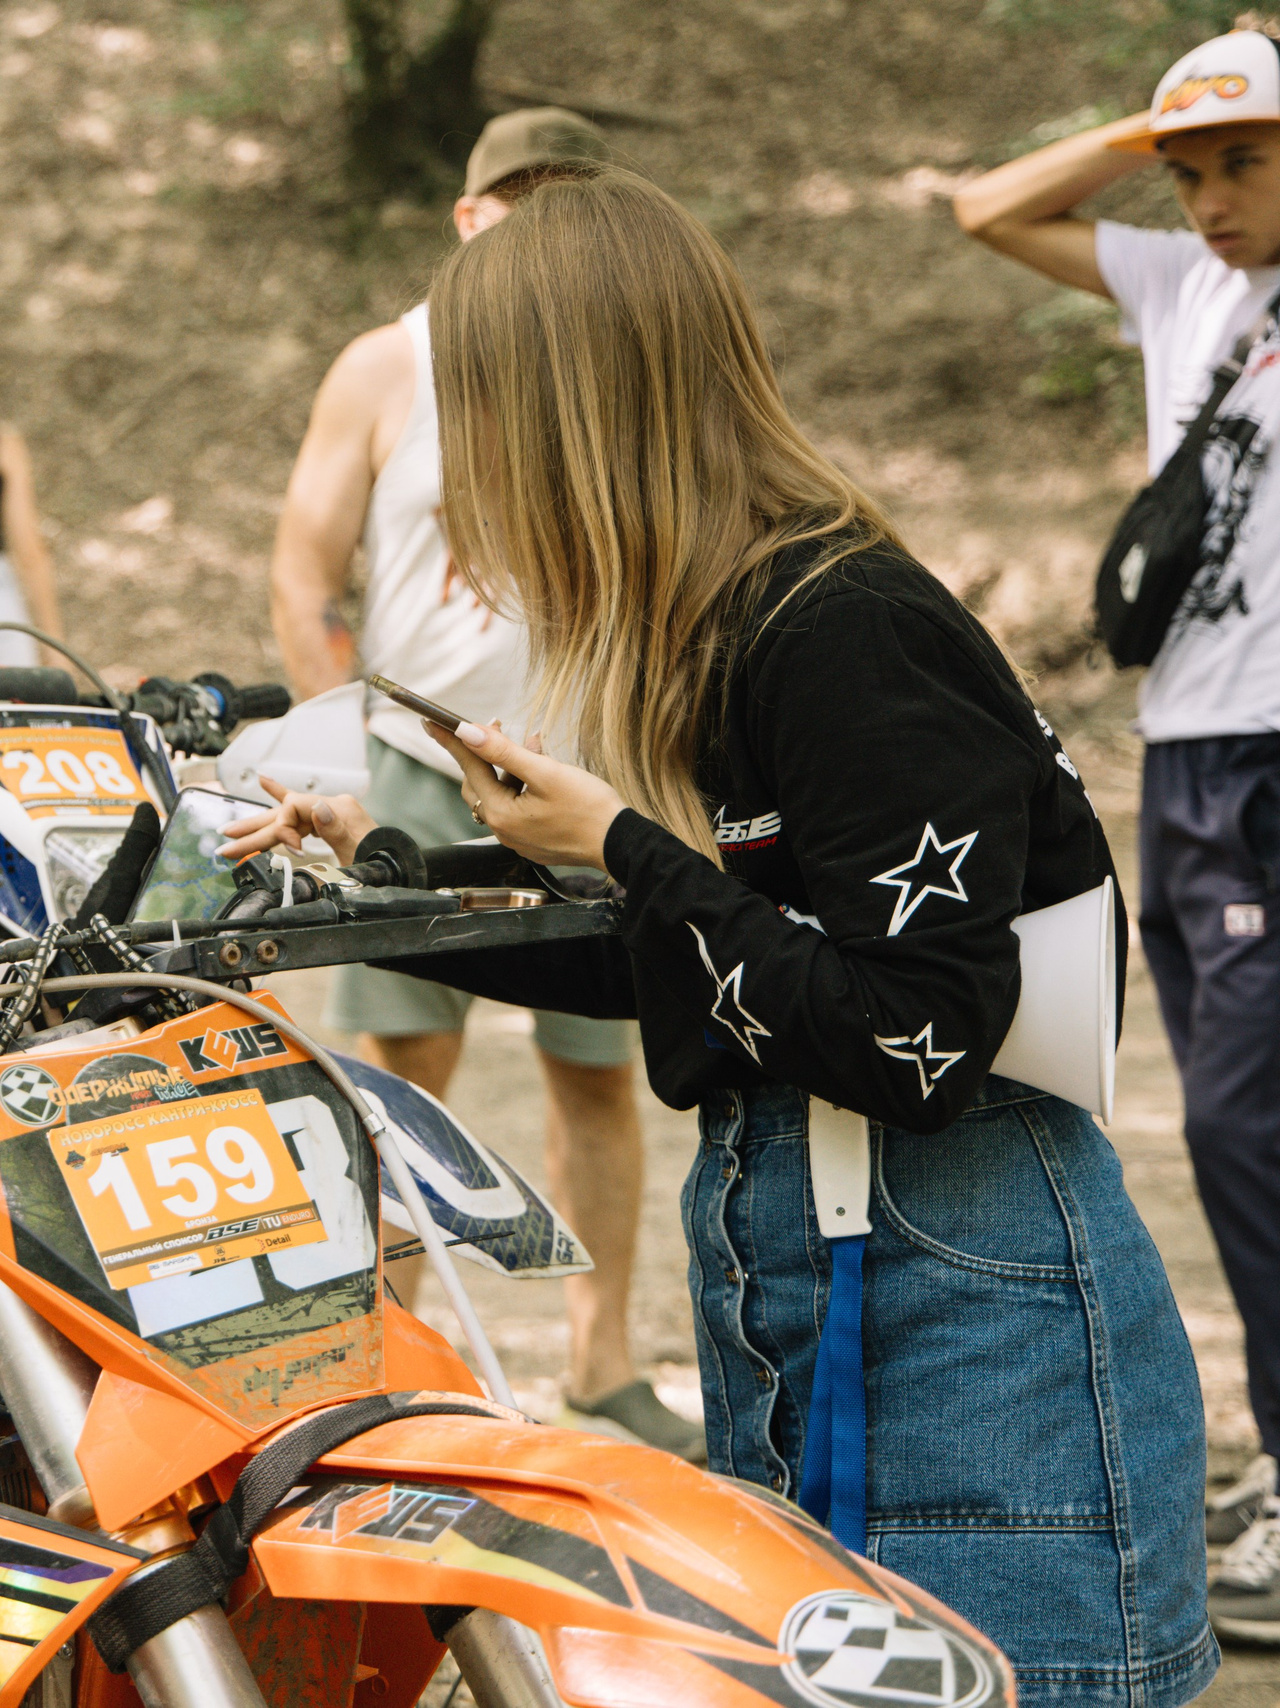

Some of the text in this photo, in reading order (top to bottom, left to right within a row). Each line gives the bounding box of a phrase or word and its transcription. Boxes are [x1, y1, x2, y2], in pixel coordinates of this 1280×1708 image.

[1, 749, 136, 796] 208
[743, 835, 778, 852] TEAM
[154, 1079, 197, 1101] RACE
[60, 1093, 259, 1147] НОВОРОСС КАНТРИ-КРОСС
[87, 1125, 275, 1232] 159
[184, 1215, 218, 1229] БРОНЗА
[204, 1217, 260, 1243] BSE
[263, 1210, 312, 1229] TU ENDURO
[102, 1232, 204, 1265] ГЕНЕРАЛЬНЫЙ СПОНСОР
[265, 1233, 292, 1247] Detail
